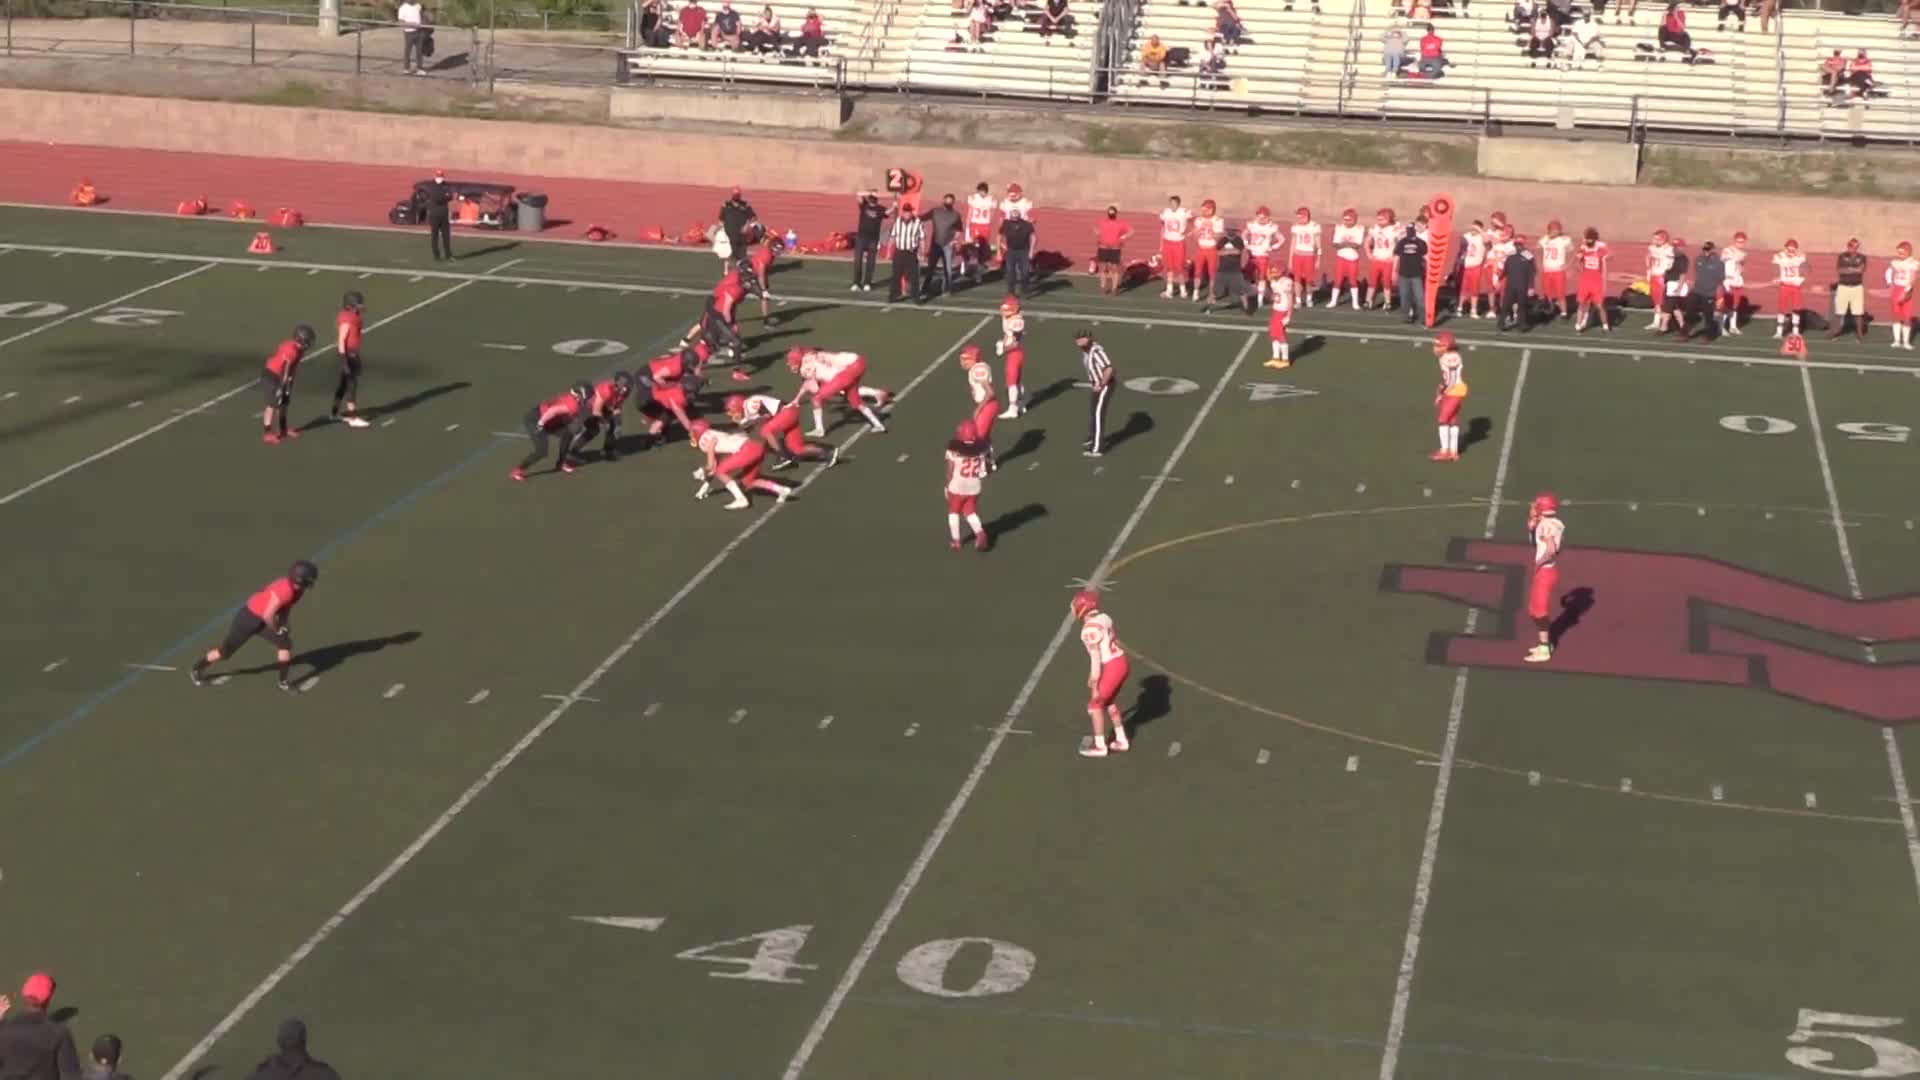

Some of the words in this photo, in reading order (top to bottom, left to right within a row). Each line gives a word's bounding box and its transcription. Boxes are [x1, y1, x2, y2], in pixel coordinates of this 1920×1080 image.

[889, 168, 902, 188] 2
[1787, 336, 1802, 352] 50
[959, 457, 981, 478] 22
[675, 924, 1037, 997] 40
